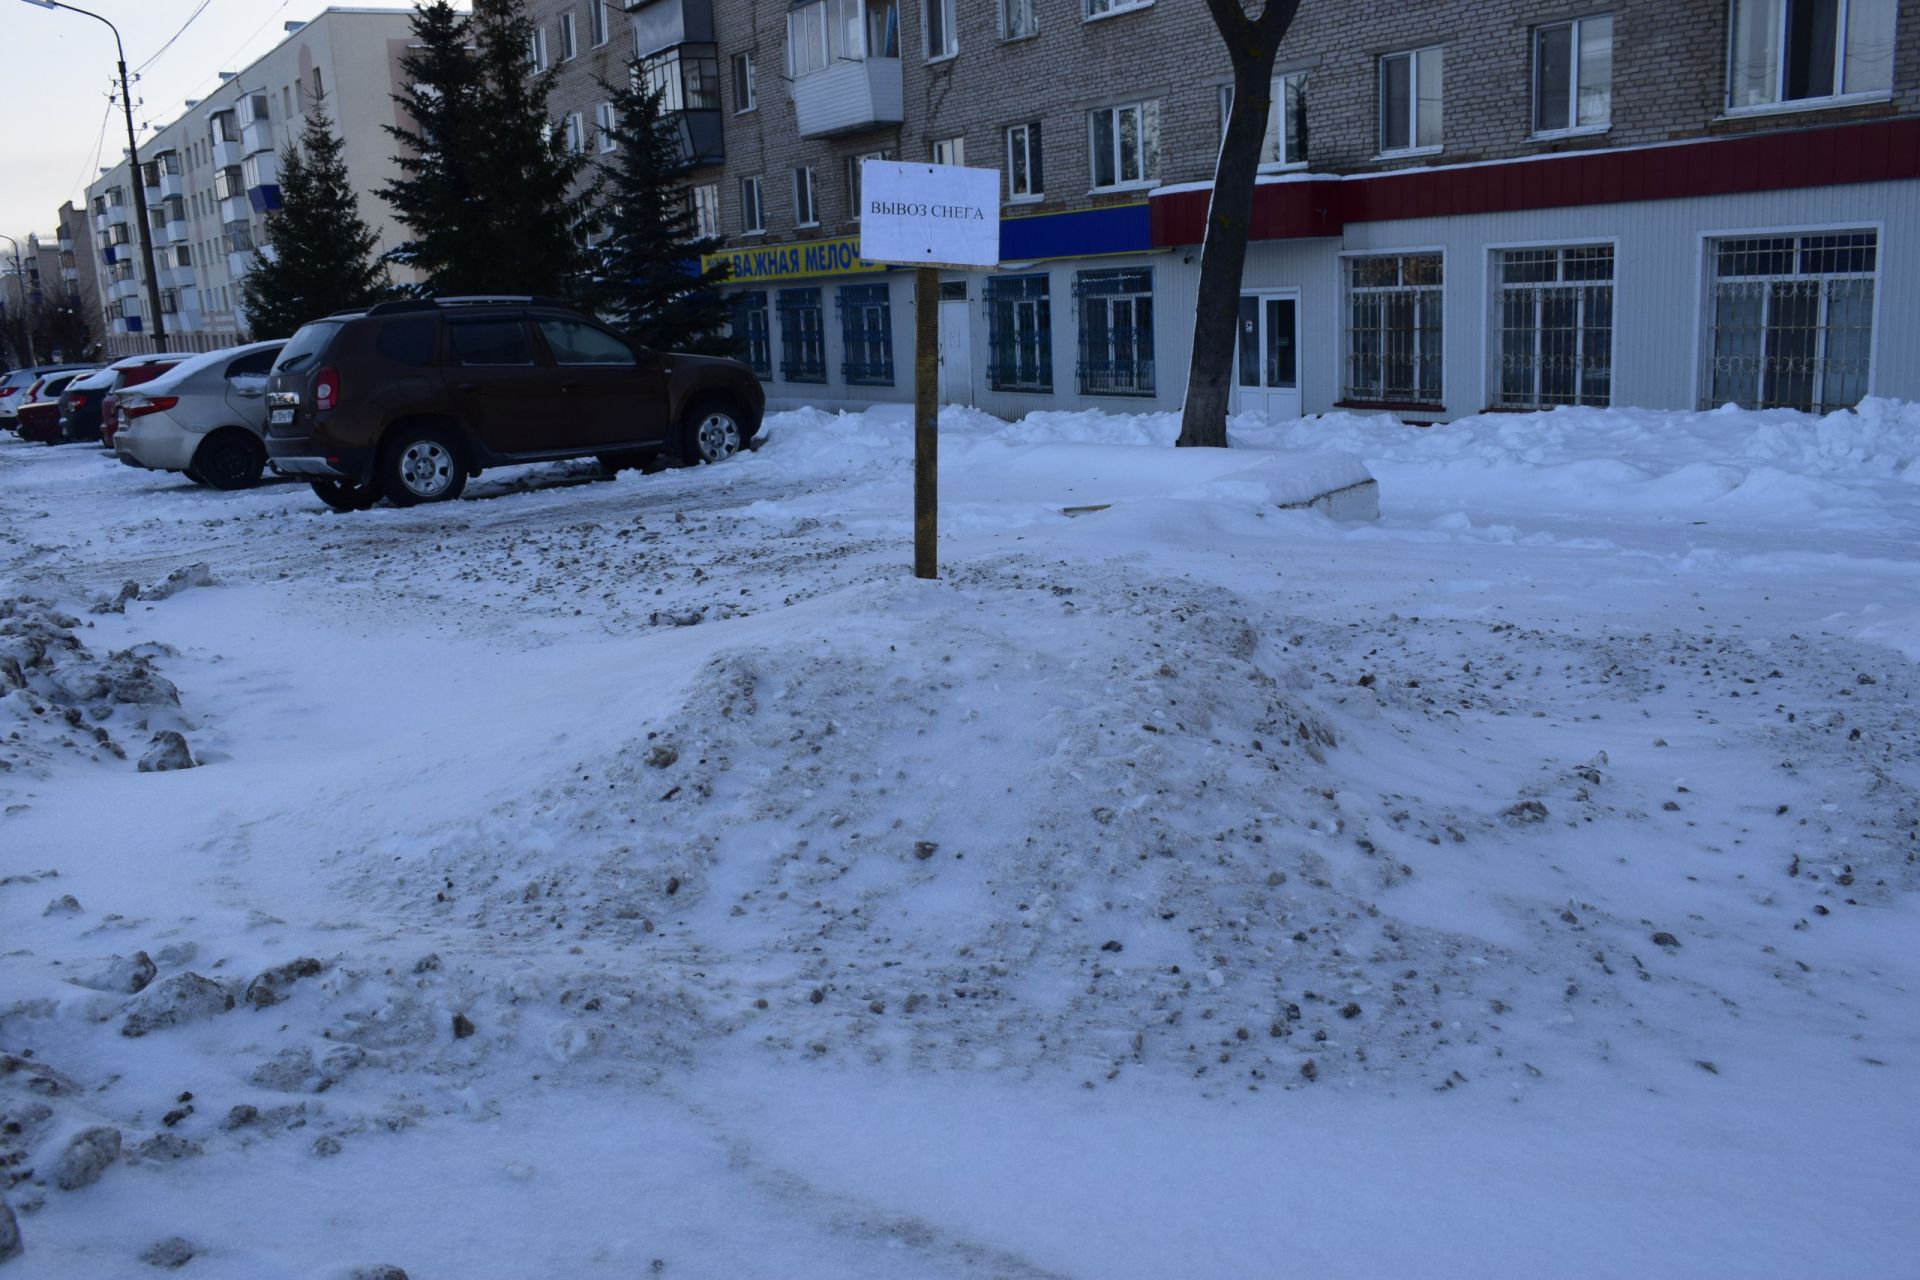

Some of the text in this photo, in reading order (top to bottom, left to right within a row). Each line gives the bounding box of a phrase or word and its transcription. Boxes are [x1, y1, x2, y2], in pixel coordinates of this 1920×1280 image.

[871, 201, 984, 220] ВЫВОЗ СНЕГА
[733, 241, 874, 278] ВАЖНАЯ МЕЛОЧ
